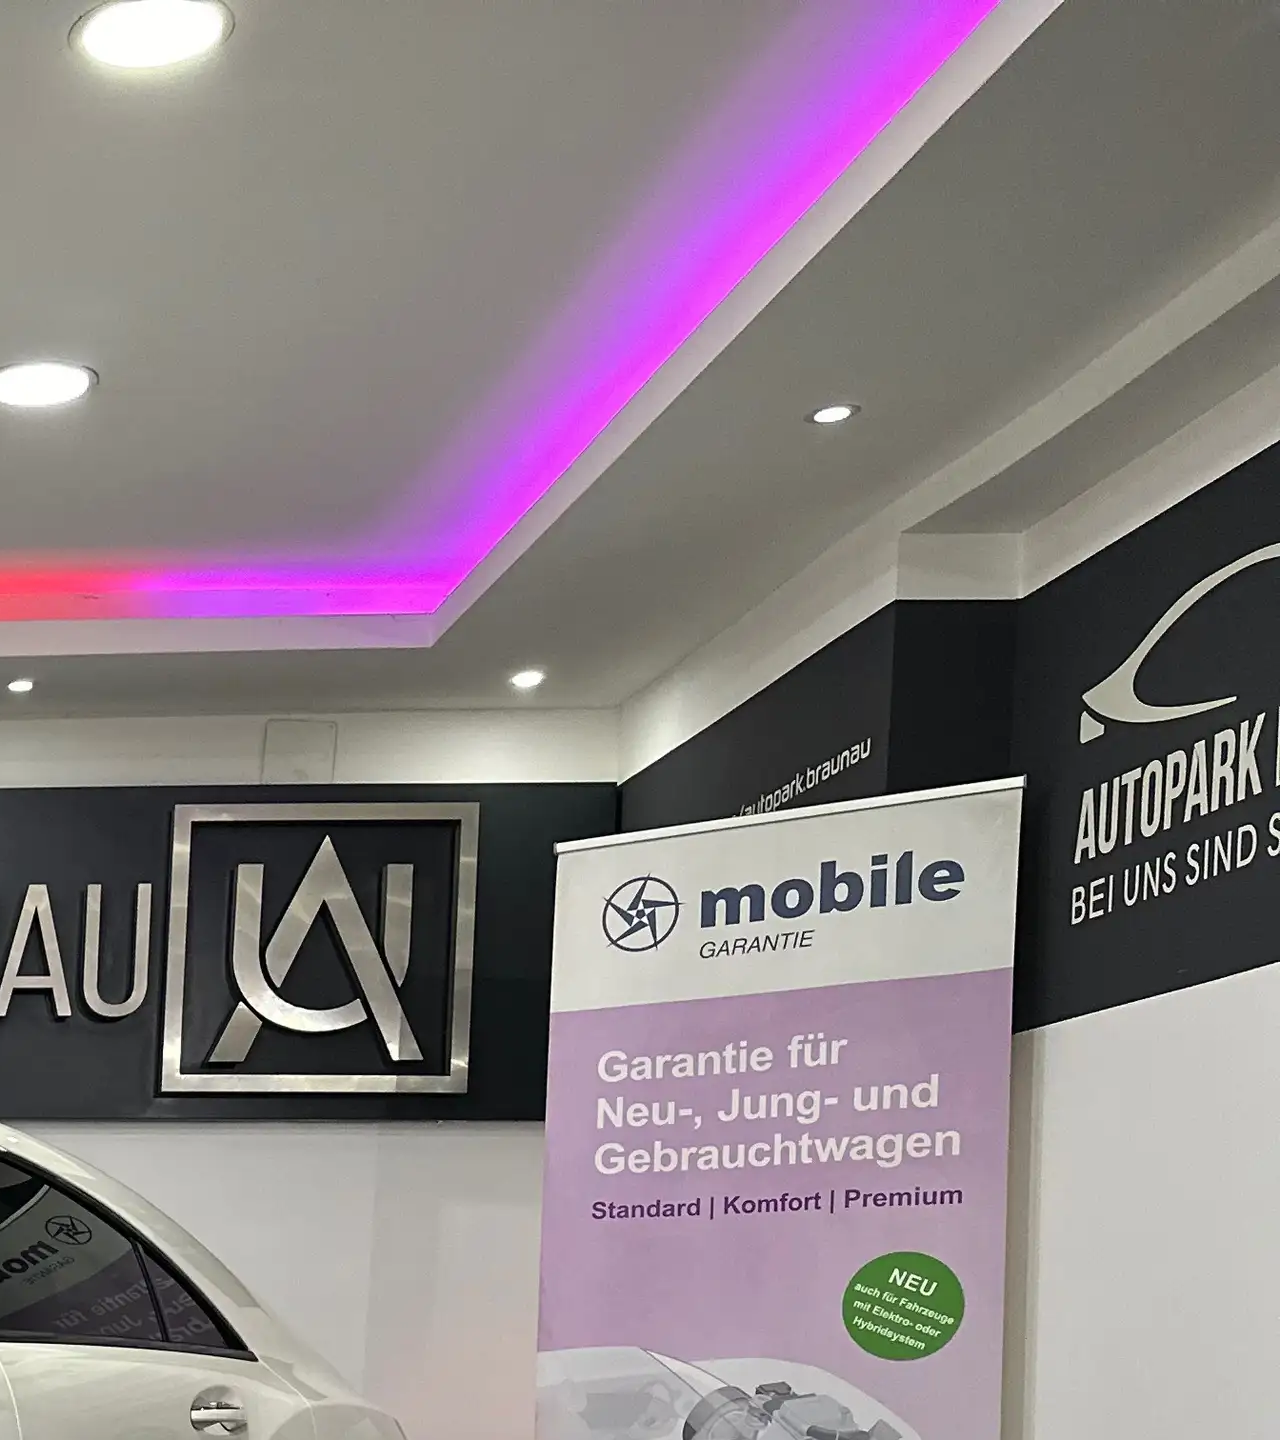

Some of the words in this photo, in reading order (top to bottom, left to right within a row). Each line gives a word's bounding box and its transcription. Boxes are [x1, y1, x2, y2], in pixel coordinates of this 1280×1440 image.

[1073, 711, 1267, 865] AUTOPARK
[699, 850, 966, 929] mobile
[1070, 874, 1114, 926] BEI
[1123, 851, 1177, 907] UNS
[1185, 823, 1258, 886] SIND
[698, 929, 816, 960] GARANTIE
[596, 1040, 773, 1083] Garantie
[786, 1032, 848, 1069] für
[595, 1095, 703, 1130] Neu-,
[716, 1086, 839, 1124] Jung-
[852, 1073, 940, 1112] und
[593, 1127, 962, 1176] Gebrauchtwagen
[591, 1197, 702, 1221] Standard
[723, 1190, 822, 1216] Komfort
[843, 1186, 964, 1209] Premium
[854, 1282, 880, 1298] auch
[881, 1290, 899, 1305] für
[899, 1297, 954, 1325] Fahrzeuge
[889, 1268, 938, 1296] NEU
[853, 1299, 871, 1313] mit
[872, 1306, 914, 1326] Elektro-
[915, 1323, 941, 1338] oder
[853, 1316, 926, 1350] Hybridsystem
